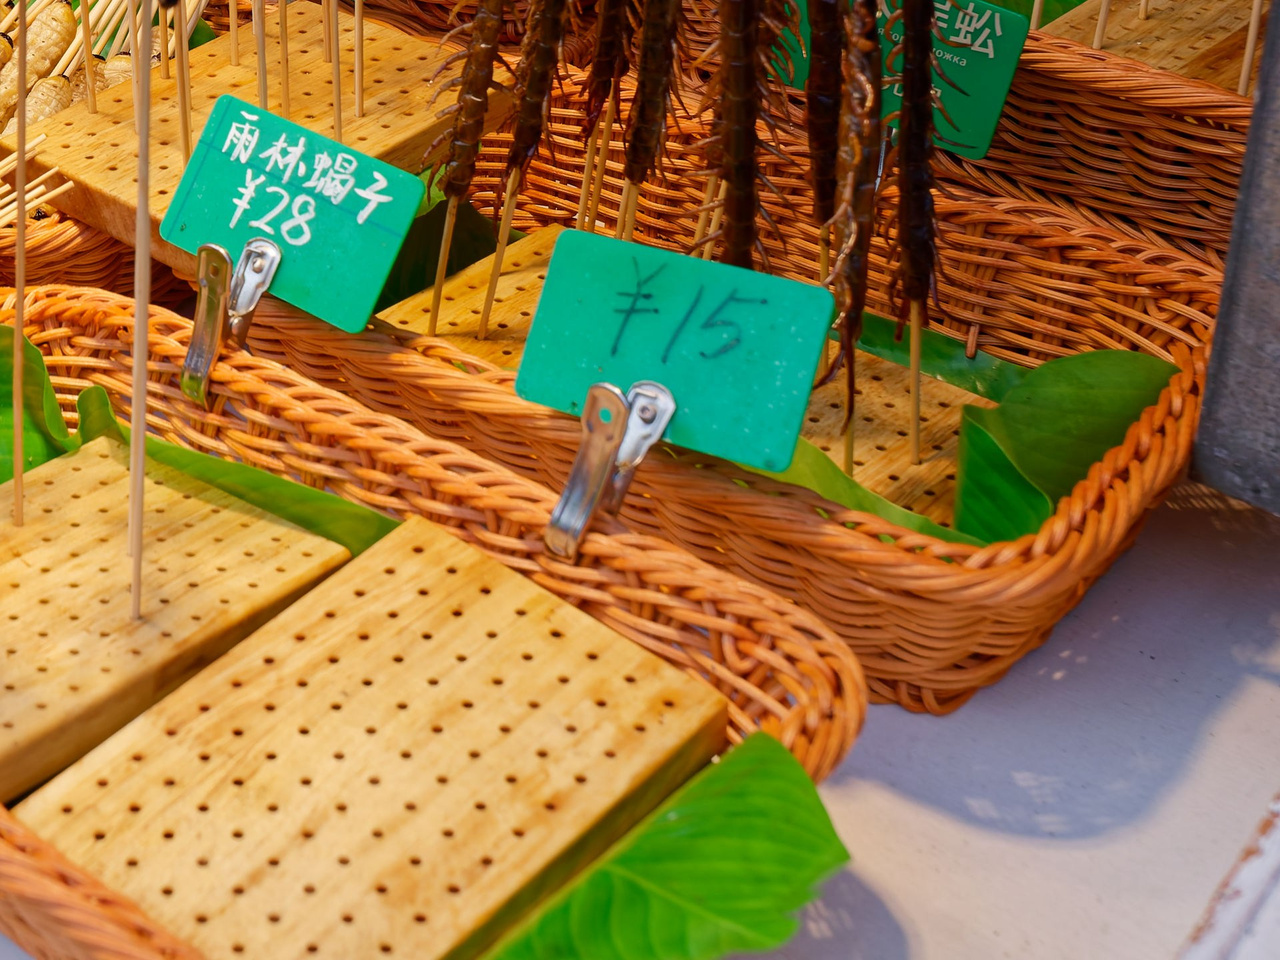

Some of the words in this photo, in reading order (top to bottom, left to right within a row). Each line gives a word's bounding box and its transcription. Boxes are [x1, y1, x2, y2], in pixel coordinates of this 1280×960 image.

[221, 110, 394, 225] 雨林蝎子
[228, 168, 317, 247] ¥28
[611, 255, 769, 366] ¥15
